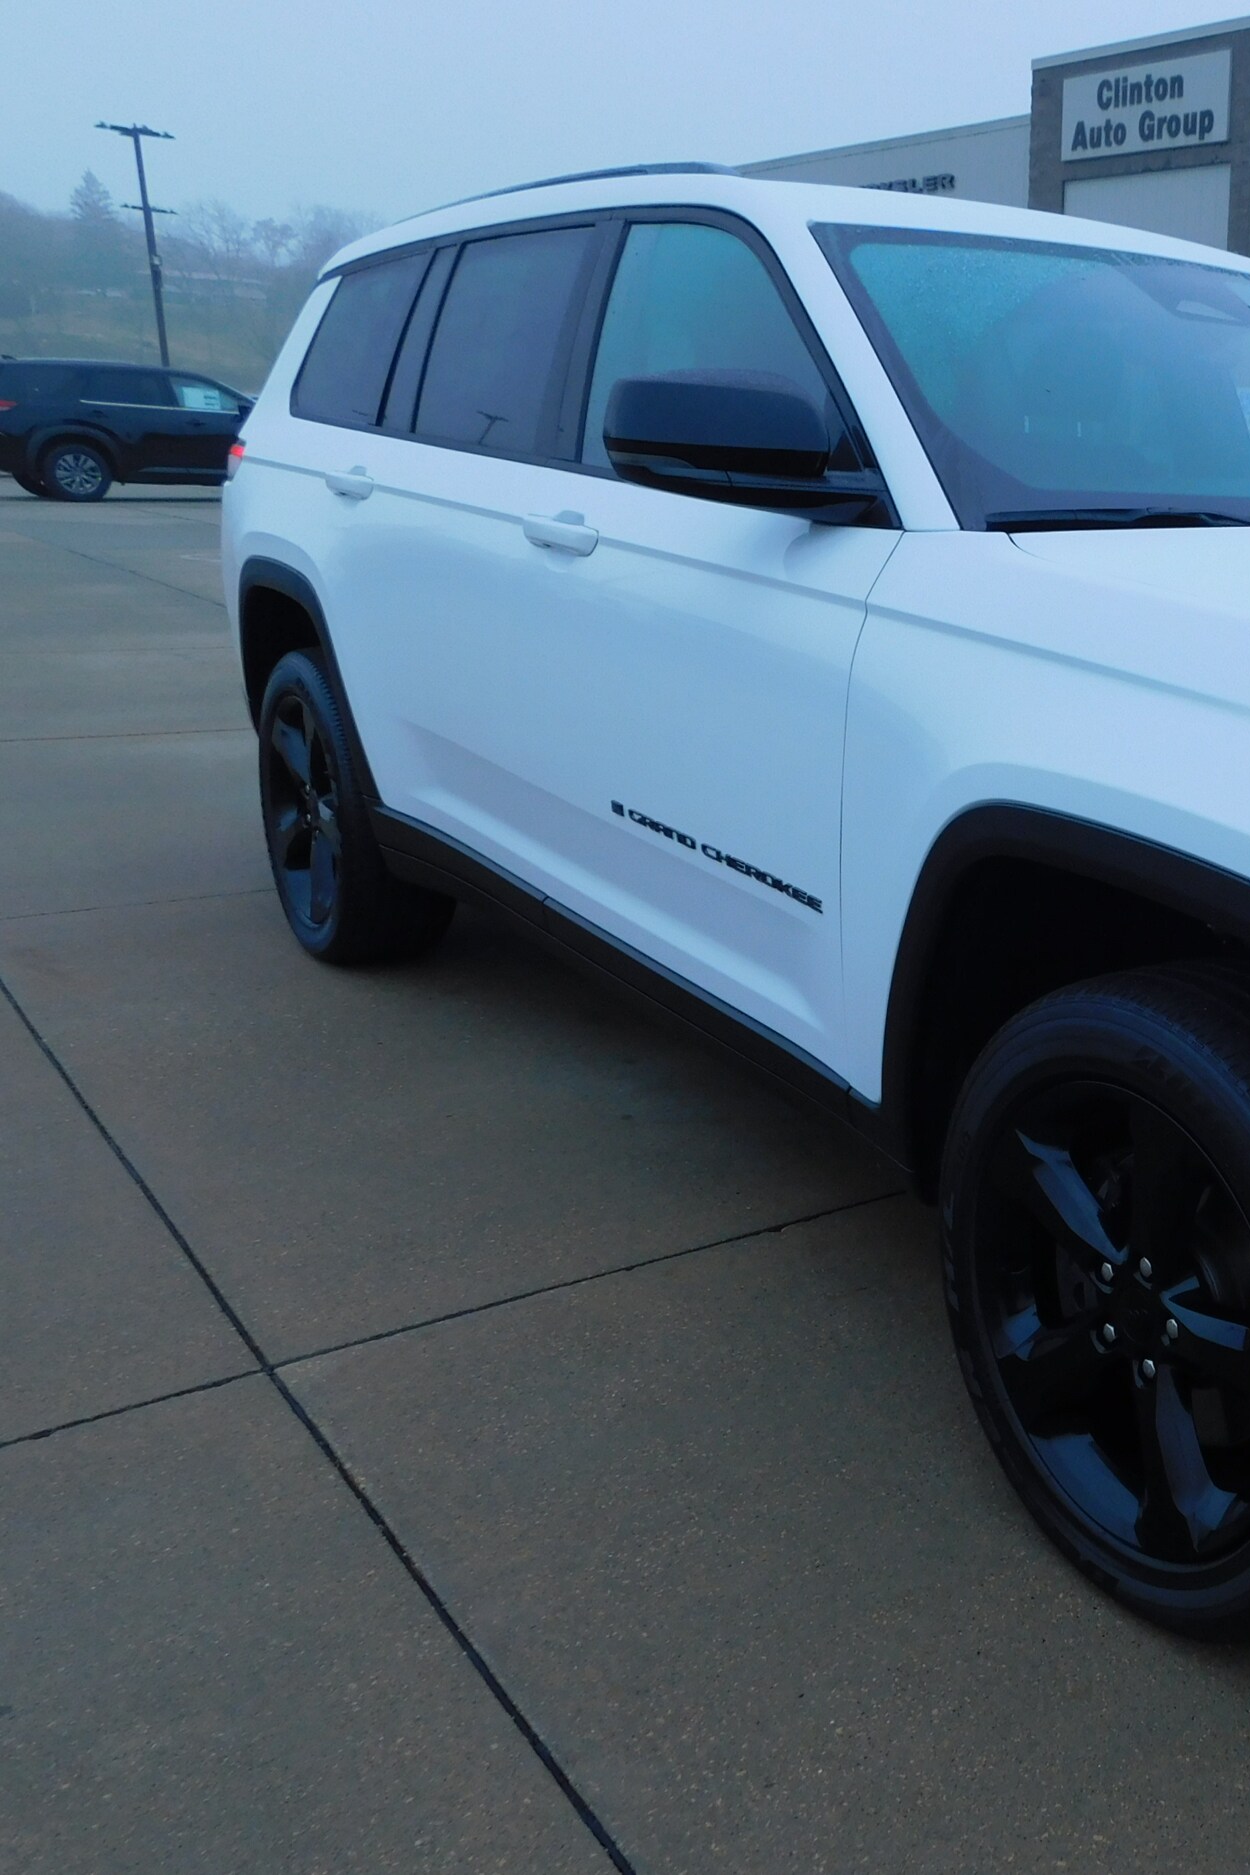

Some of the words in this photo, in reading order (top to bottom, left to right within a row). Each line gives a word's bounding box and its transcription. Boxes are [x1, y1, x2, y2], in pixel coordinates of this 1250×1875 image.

[1097, 74, 1184, 111] Clinton
[1071, 118, 1127, 151] Auto
[1139, 109, 1214, 142] Group
[628, 809, 697, 851] GRAND
[701, 843, 824, 914] CHEROKEE
